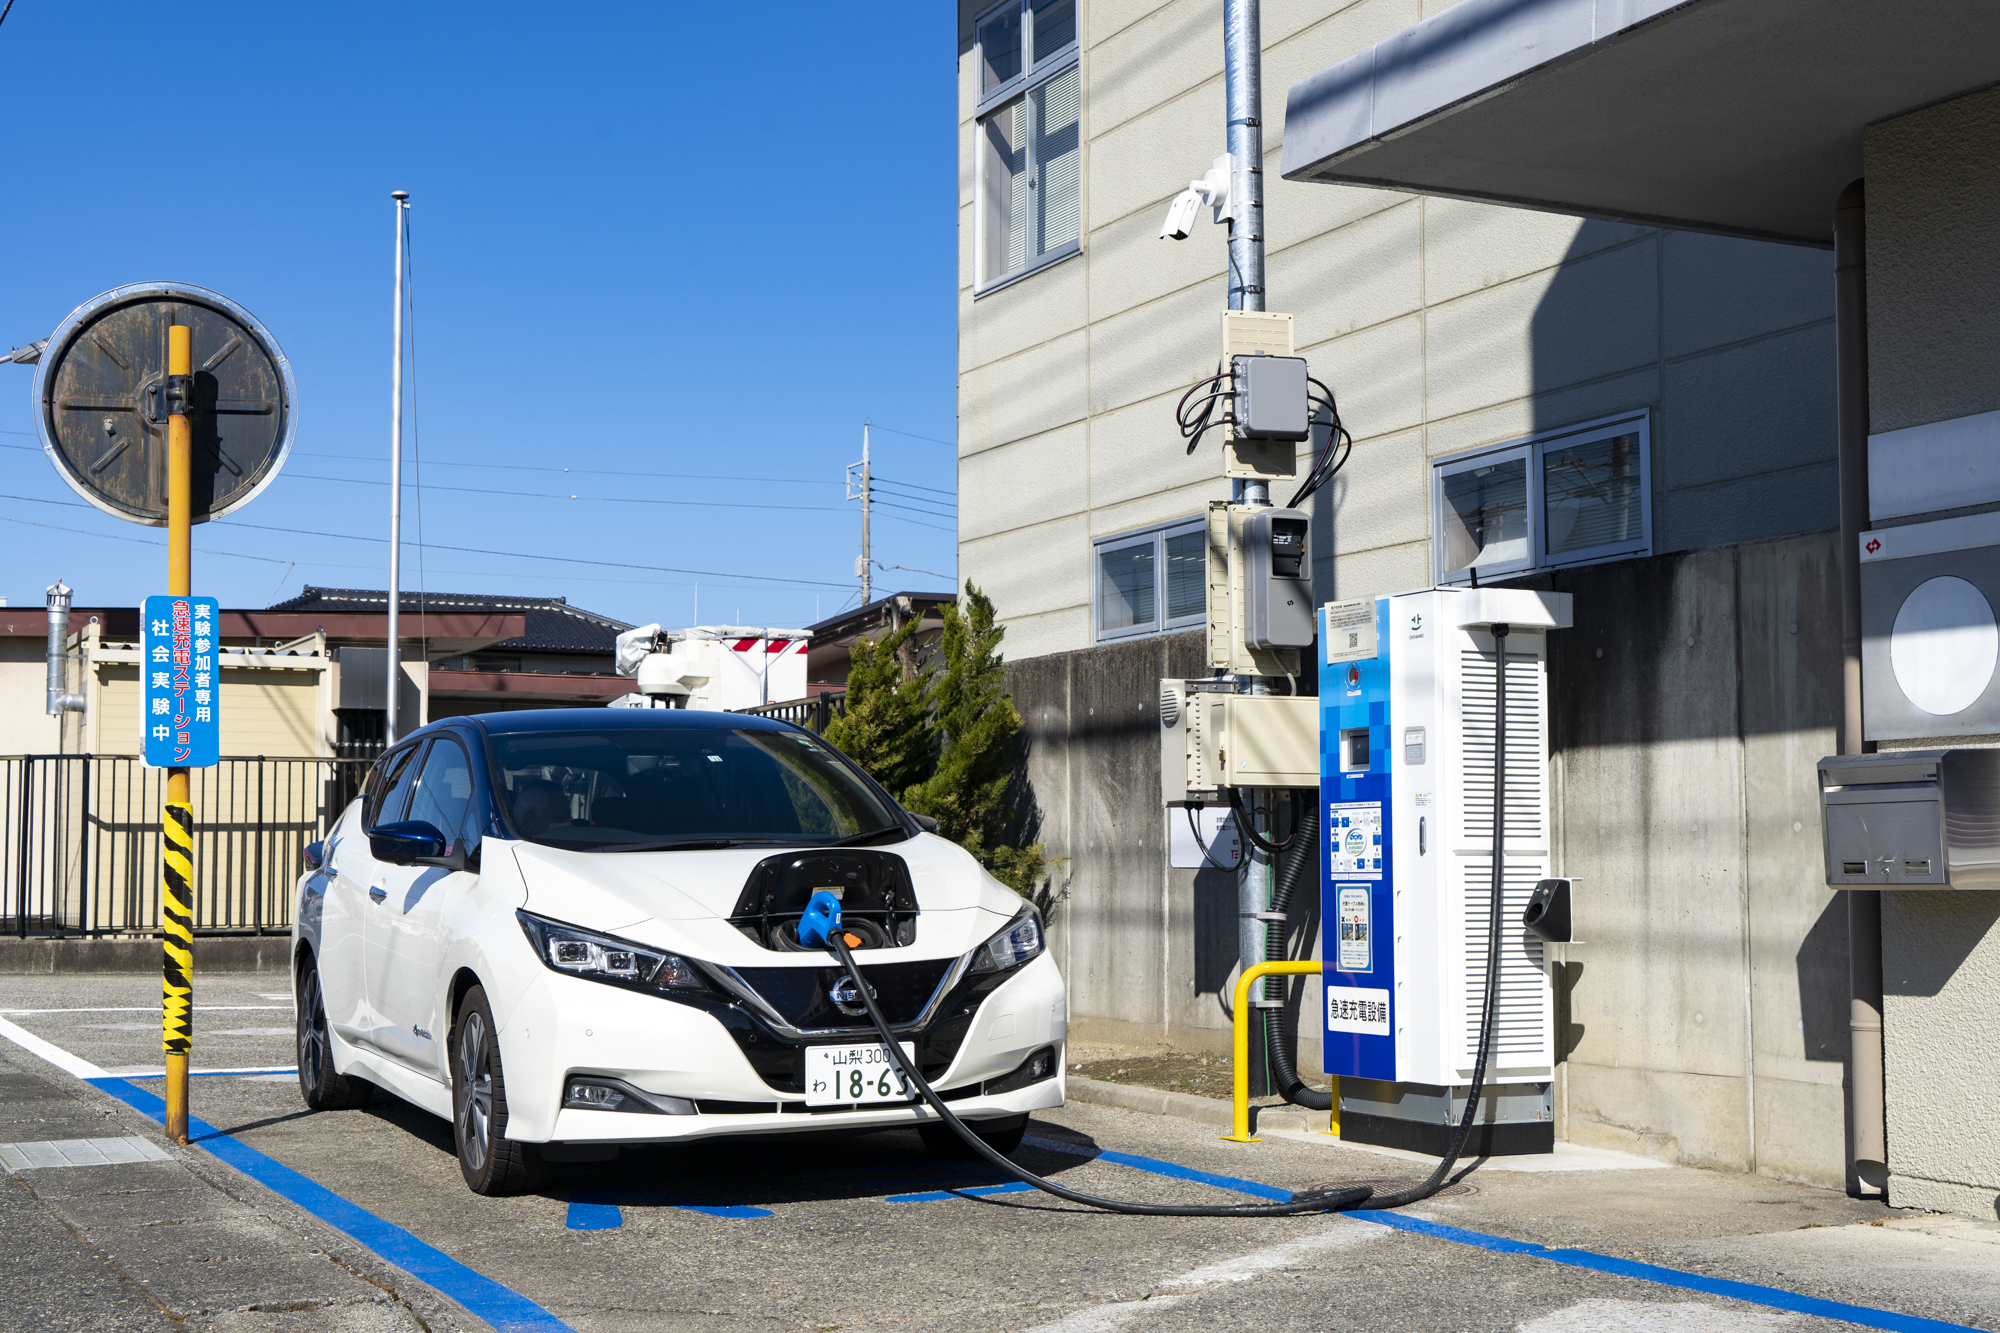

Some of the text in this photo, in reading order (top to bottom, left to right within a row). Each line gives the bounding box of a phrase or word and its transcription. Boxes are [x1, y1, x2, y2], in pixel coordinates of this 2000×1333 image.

[151, 619, 171, 741] 社会実験中
[172, 600, 191, 762] 急速充電ステーション
[194, 604, 211, 722] 実験参加者専用
[1331, 998, 1387, 1023] 急速充電設備
[812, 1067, 909, 1100] わ 18-63
